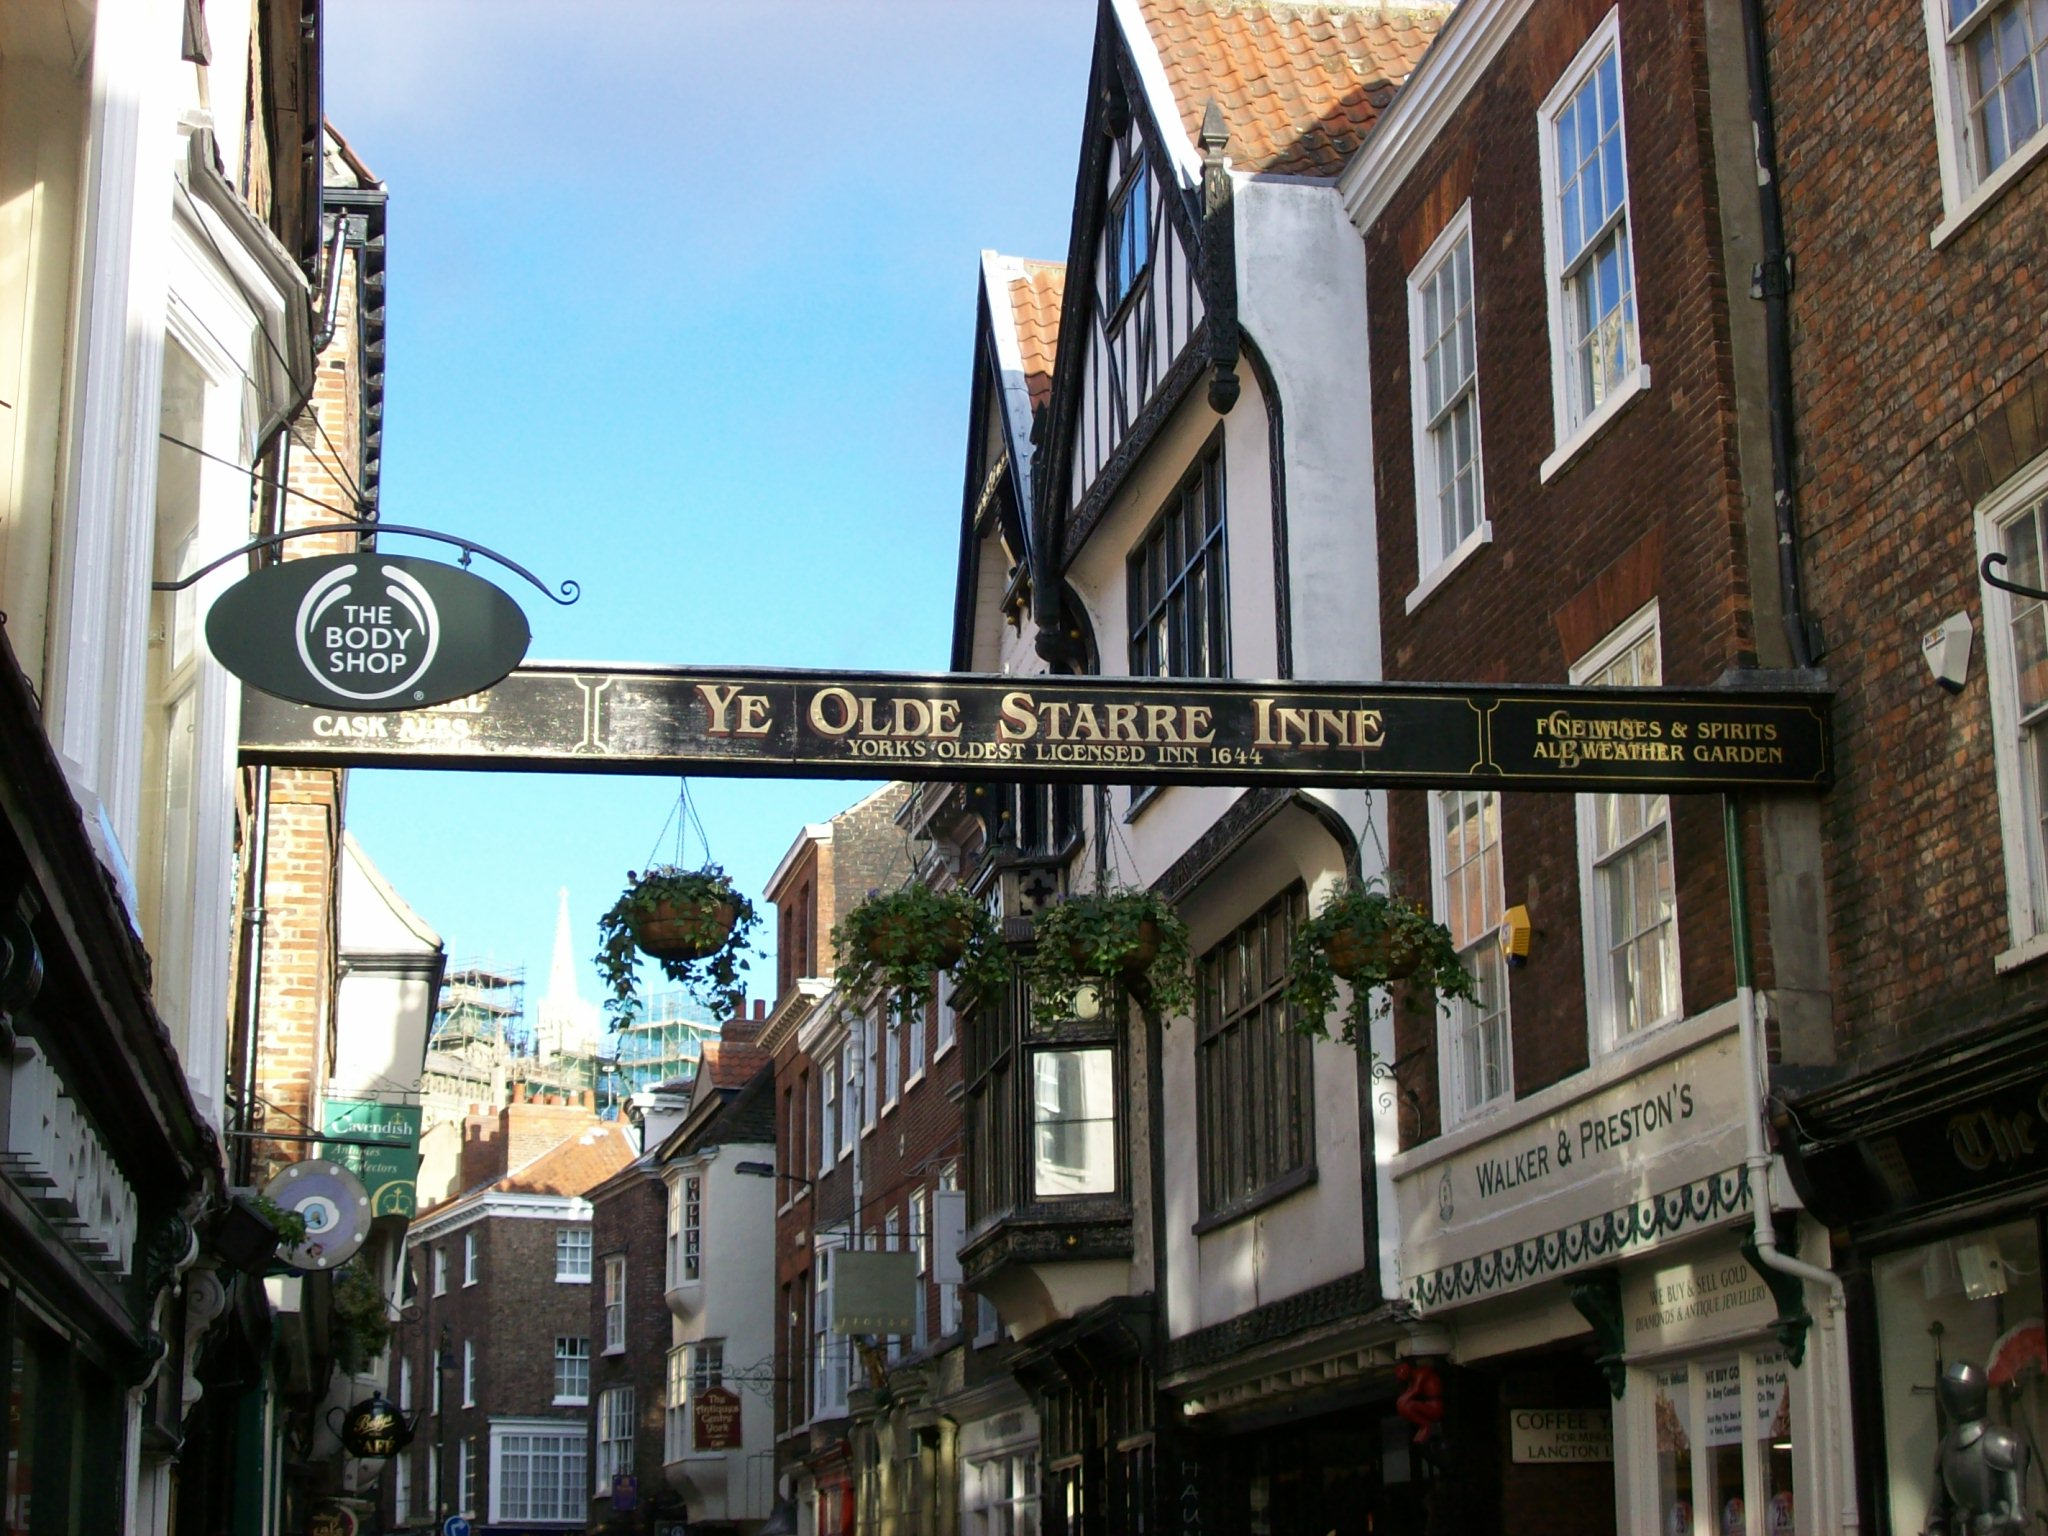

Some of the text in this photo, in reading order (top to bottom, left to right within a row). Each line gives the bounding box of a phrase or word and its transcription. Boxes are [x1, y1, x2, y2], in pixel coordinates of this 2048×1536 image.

[344, 606, 392, 624] THE
[326, 627, 412, 649] BODY
[330, 652, 407, 673] SHOP
[313, 715, 472, 740] CASK ALES
[1671, 722, 1687, 738] &
[1697, 723, 1777, 740] SPIRITS
[849, 738, 1263, 765] YORK'S OLDEST LICENSED INN 1644
[1582, 743, 1685, 761] WEATHER
[1694, 745, 1783, 763] GARDEN
[331, 1115, 413, 1136] Cavendish
[1476, 1083, 1693, 1198] WALKER & PRESTON'S
[1946, 1106, 2036, 1172] The
[688, 1178, 698, 1268] GALLERY
[1649, 1265, 1747, 1306] WE BUY & SELL GOLD
[1636, 1284, 1767, 1332] DIAMONDS & ANTIQUE JEWELLERY
[1516, 1412, 1588, 1430] COFFEE
[1528, 1445, 1599, 1459] LANGTON
